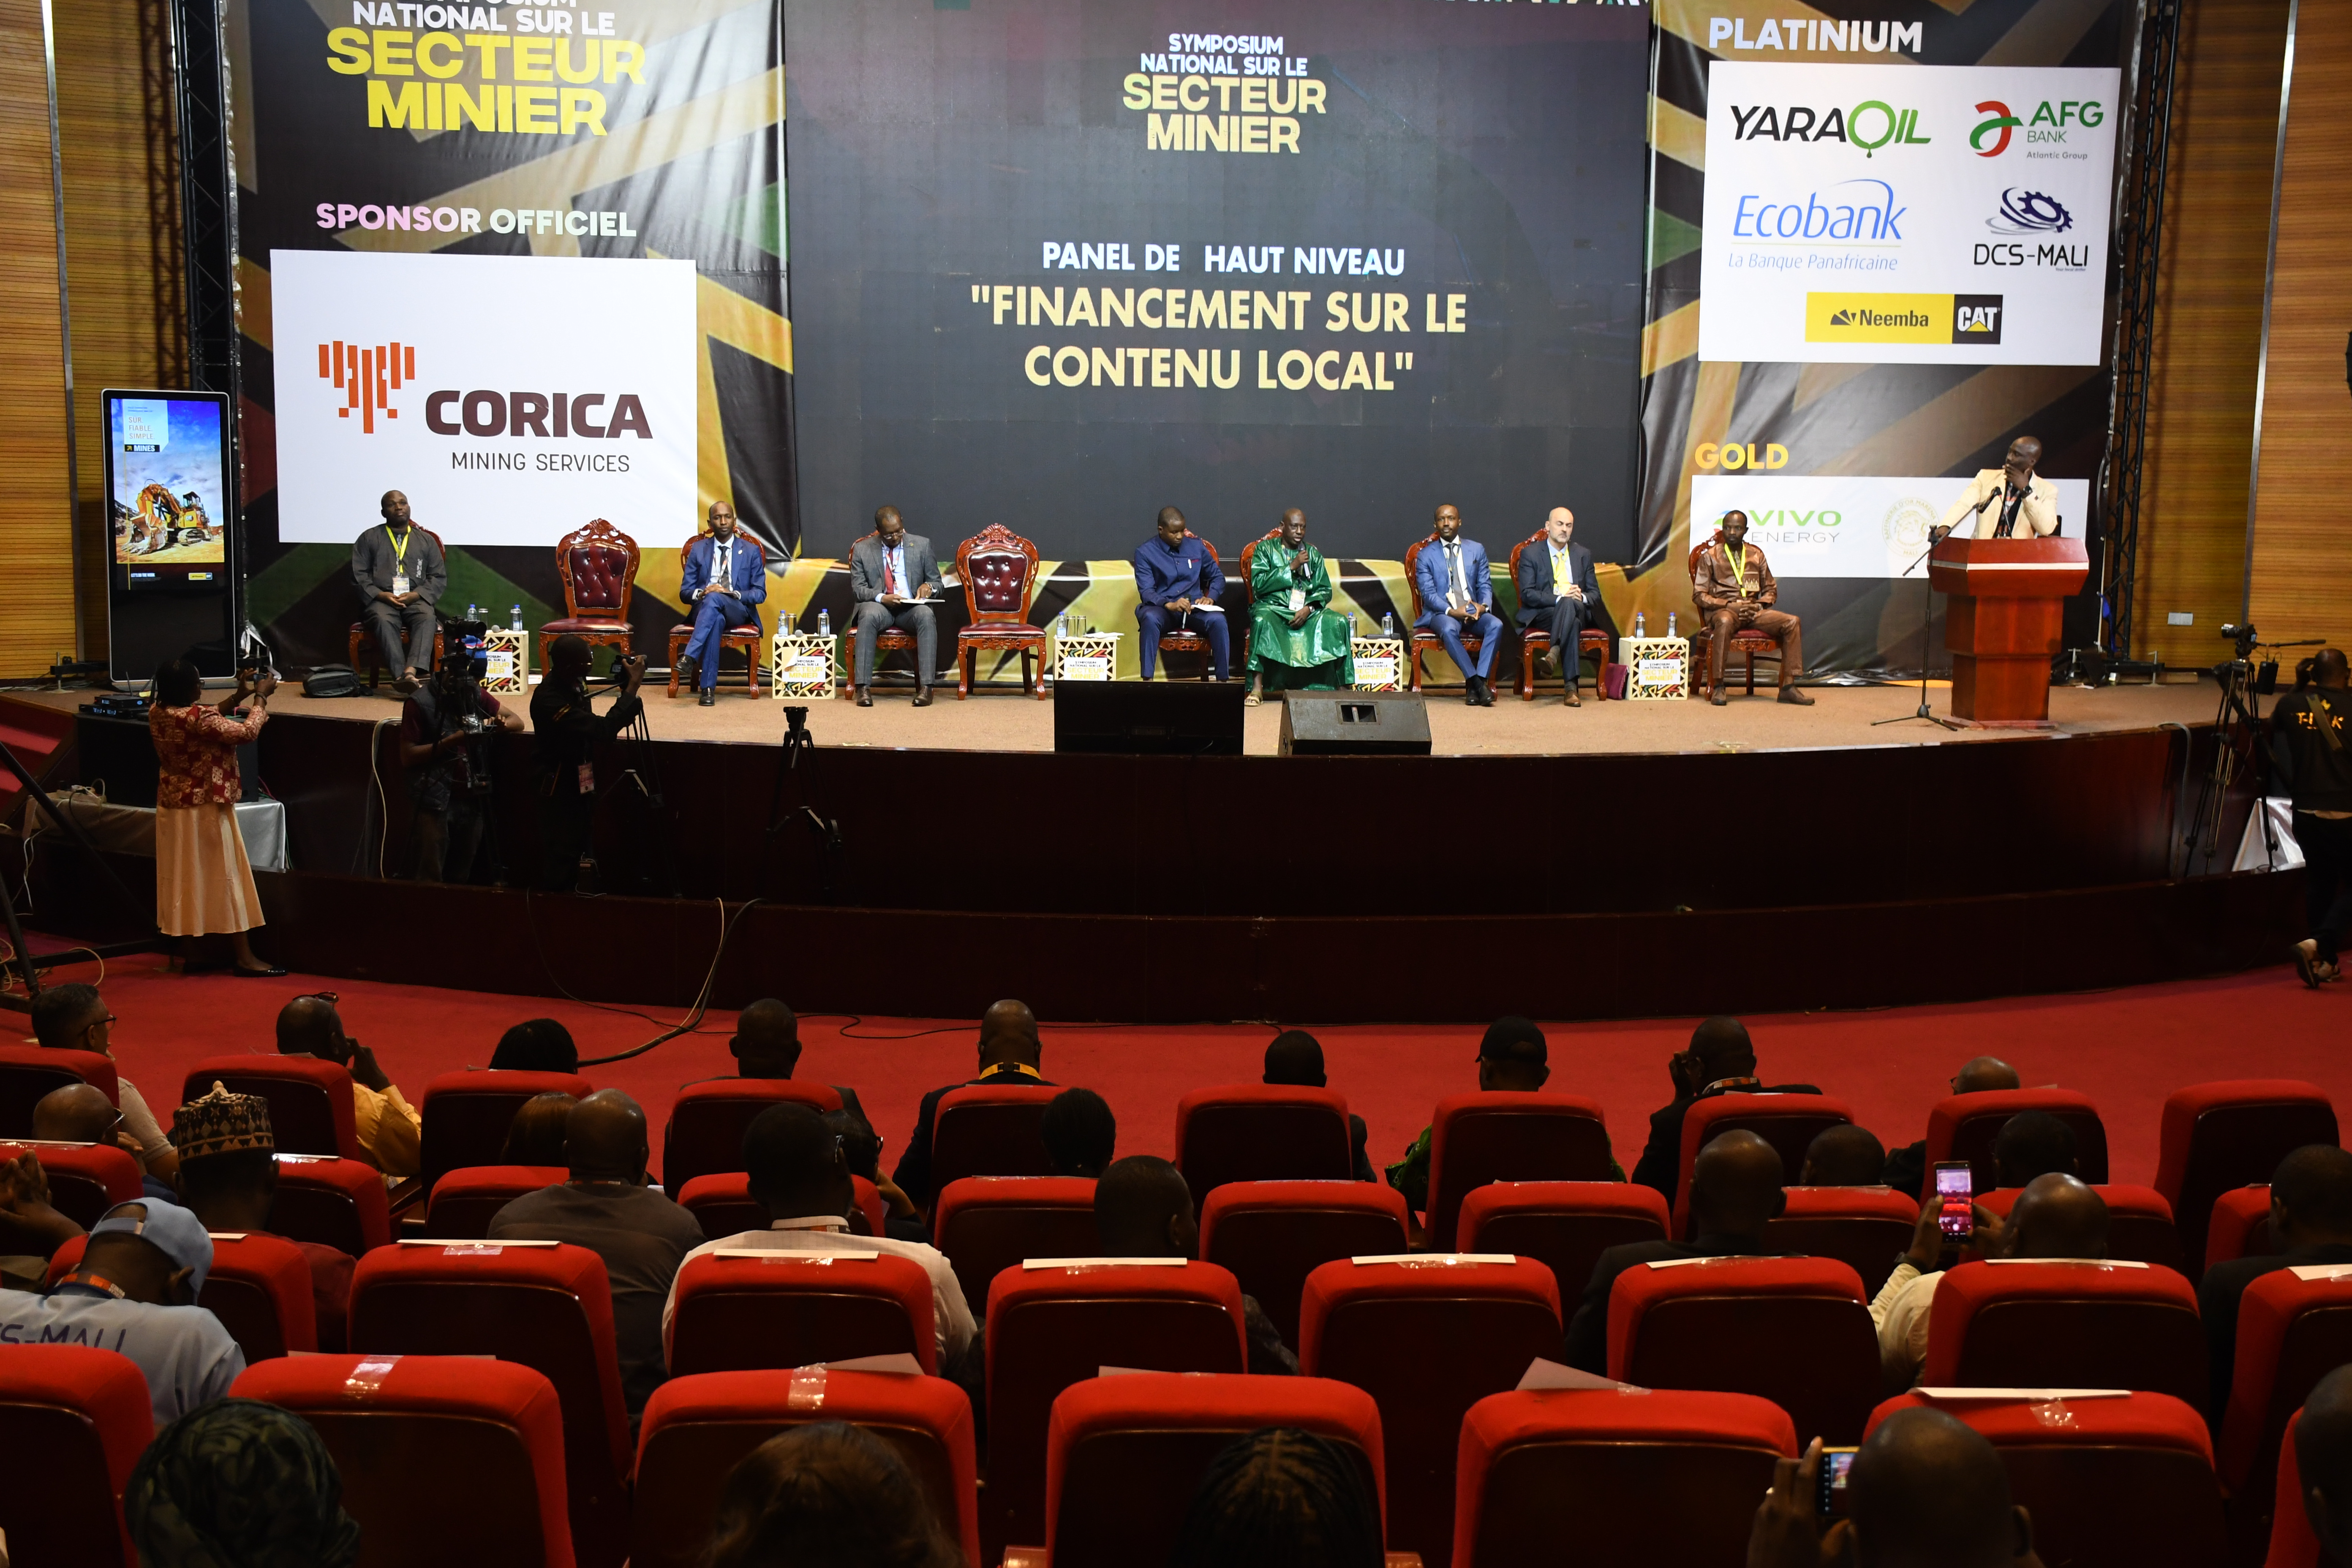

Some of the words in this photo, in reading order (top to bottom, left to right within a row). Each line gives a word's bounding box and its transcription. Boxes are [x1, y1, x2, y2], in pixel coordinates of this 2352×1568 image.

[354, 2, 507, 32] NATIONAL
[516, 8, 573, 35] SUR
[581, 11, 615, 36] LE
[1169, 33, 1283, 55] SYMPOSIUM
[1709, 18, 1922, 53] PLATINIUM
[327, 27, 646, 85] SECTEUR
[1141, 53, 1238, 75] NATIONAL
[1244, 57, 1280, 76] SUR
[1285, 57, 1307, 76] LE
[1123, 73, 1326, 114] SECTEUR
[367, 80, 607, 136] MINIER
[2028, 101, 2104, 128] AFG
[1147, 113, 1300, 154] MINIER
[2027, 131, 2067, 143] BANK
[2062, 152, 2088, 161] Group
[316, 203, 482, 234] SPONSOR
[489, 208, 637, 237] OFFICIEL
[1734, 179, 1907, 240] Ecobank
[1043, 242, 1135, 271] PANEL
[1145, 244, 1180, 272] DE
[1204, 245, 1282, 274] HAUT
[1294, 247, 1405, 276] NIVEAU
[1729, 253, 1744, 268] La
[1749, 254, 1802, 272] Banque
[1808, 253, 1897, 271] Panafricaine
[1974, 244, 2088, 267] DCS-MALI
[971, 285, 1311, 331] "FINANCEMENT
[1326, 292, 1410, 333] SUR
[1426, 293, 1467, 333] LE
[1859, 310, 1929, 327] Neemba
[1957, 306, 1997, 332] CAT
[1025, 346, 1241, 389] CONTENU
[1258, 349, 1414, 391] LOCAL"
[425, 389, 653, 439] CORICA
[452, 452, 526, 471] MINING
[536, 453, 630, 472] SERVICES
[1695, 442, 1788, 470] GOLD
[1748, 509, 1841, 526] VIVO
[1751, 532, 1840, 543] ENERGY
